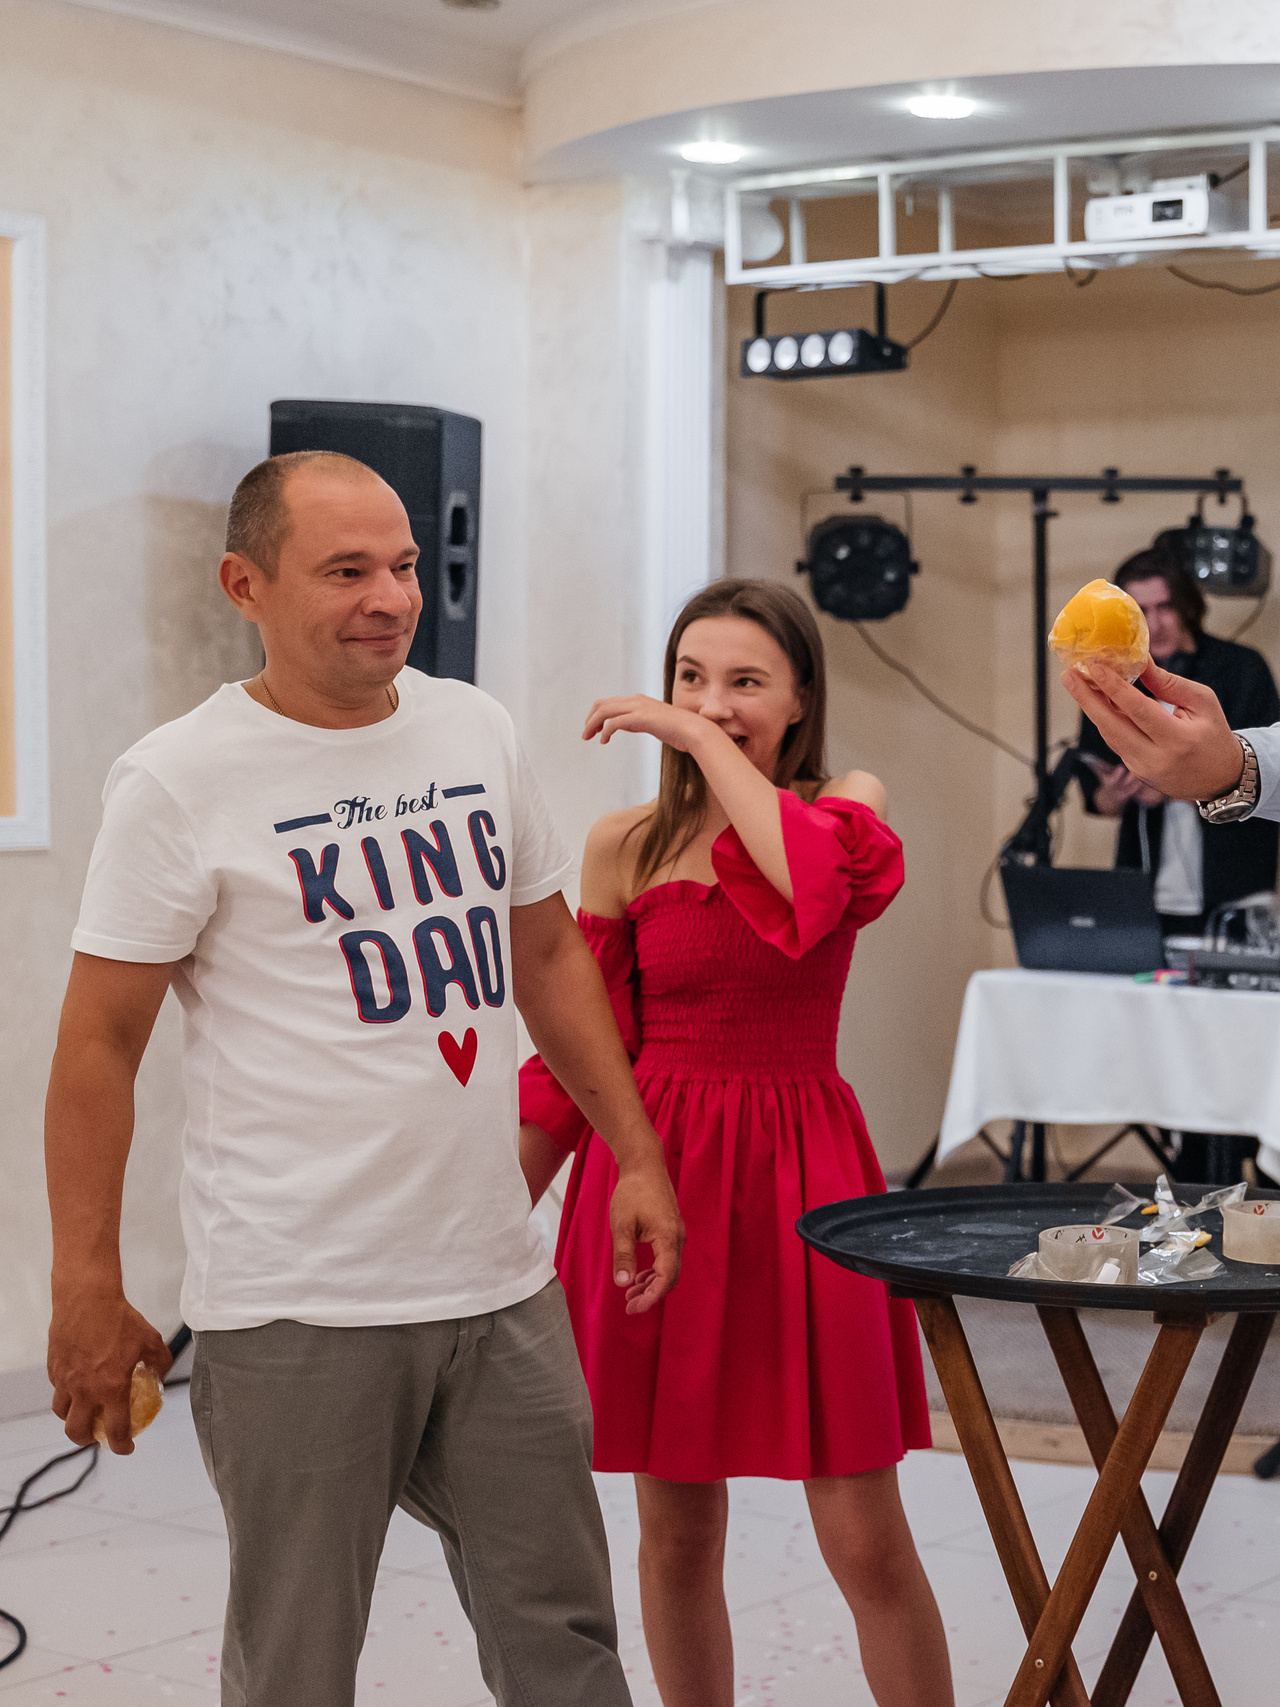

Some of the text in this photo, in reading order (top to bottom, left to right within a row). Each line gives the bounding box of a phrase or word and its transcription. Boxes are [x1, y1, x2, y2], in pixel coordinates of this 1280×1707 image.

[333, 782, 439, 829] The best
[287, 809, 506, 923] KING
[338, 905, 506, 1024] DAD
